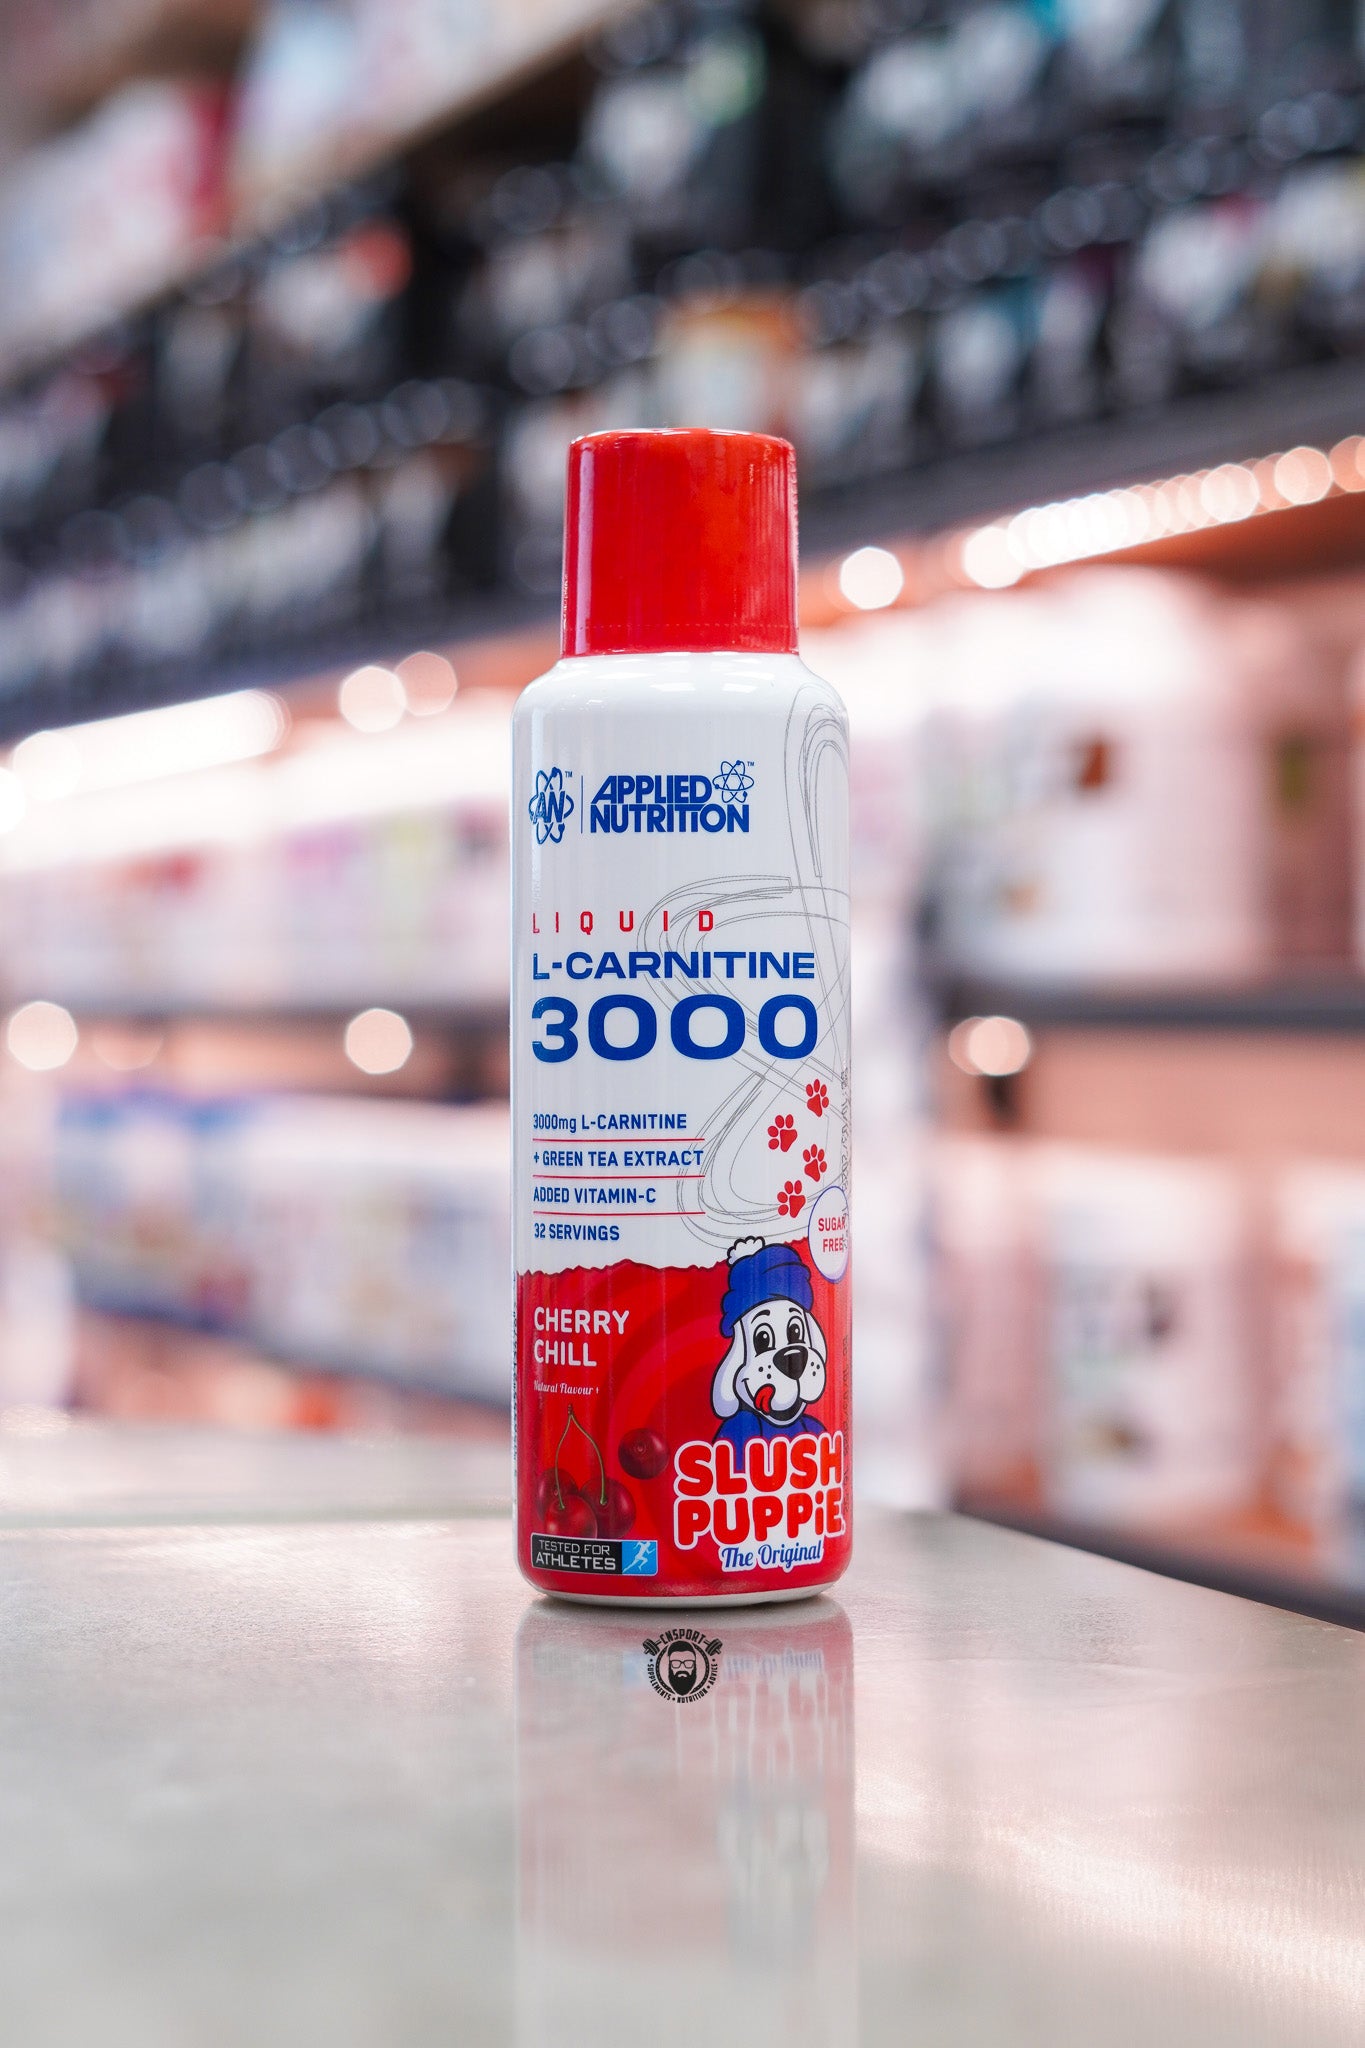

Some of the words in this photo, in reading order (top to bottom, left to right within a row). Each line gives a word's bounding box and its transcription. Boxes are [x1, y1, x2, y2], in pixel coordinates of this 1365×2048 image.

[591, 775, 713, 804] APPLIED
[590, 803, 750, 833] NUTRITION
[532, 910, 714, 935] LIQUID
[532, 951, 815, 980] L-CARNITINE
[531, 993, 818, 1063] 3000
[533, 1113, 577, 1133] 3000mg
[581, 1113, 687, 1130] L-CARNITINE
[542, 1150, 583, 1167] GREEN
[588, 1151, 619, 1167] TEA
[624, 1150, 704, 1167] EXTRACT
[533, 1186, 570, 1203] ADDED
[574, 1187, 656, 1204] VITAMIN-C
[534, 1222, 546, 1239] 32
[549, 1223, 620, 1241] SERVINGS
[818, 1217, 846, 1232] SUGAR
[822, 1237, 845, 1253] FREE
[533, 1306, 630, 1335] CHERRY
[533, 1338, 597, 1367] CHILL
[533, 1379, 558, 1393] Natural
[560, 1382, 594, 1395] Flavour
[676, 1432, 843, 1497] SLUSH
[538, 1539, 581, 1554] TESTED
[584, 1544, 610, 1556] FOR
[721, 1547, 753, 1568] The
[758, 1540, 822, 1569] Original
[535, 1552, 616, 1571] ATHLETES
